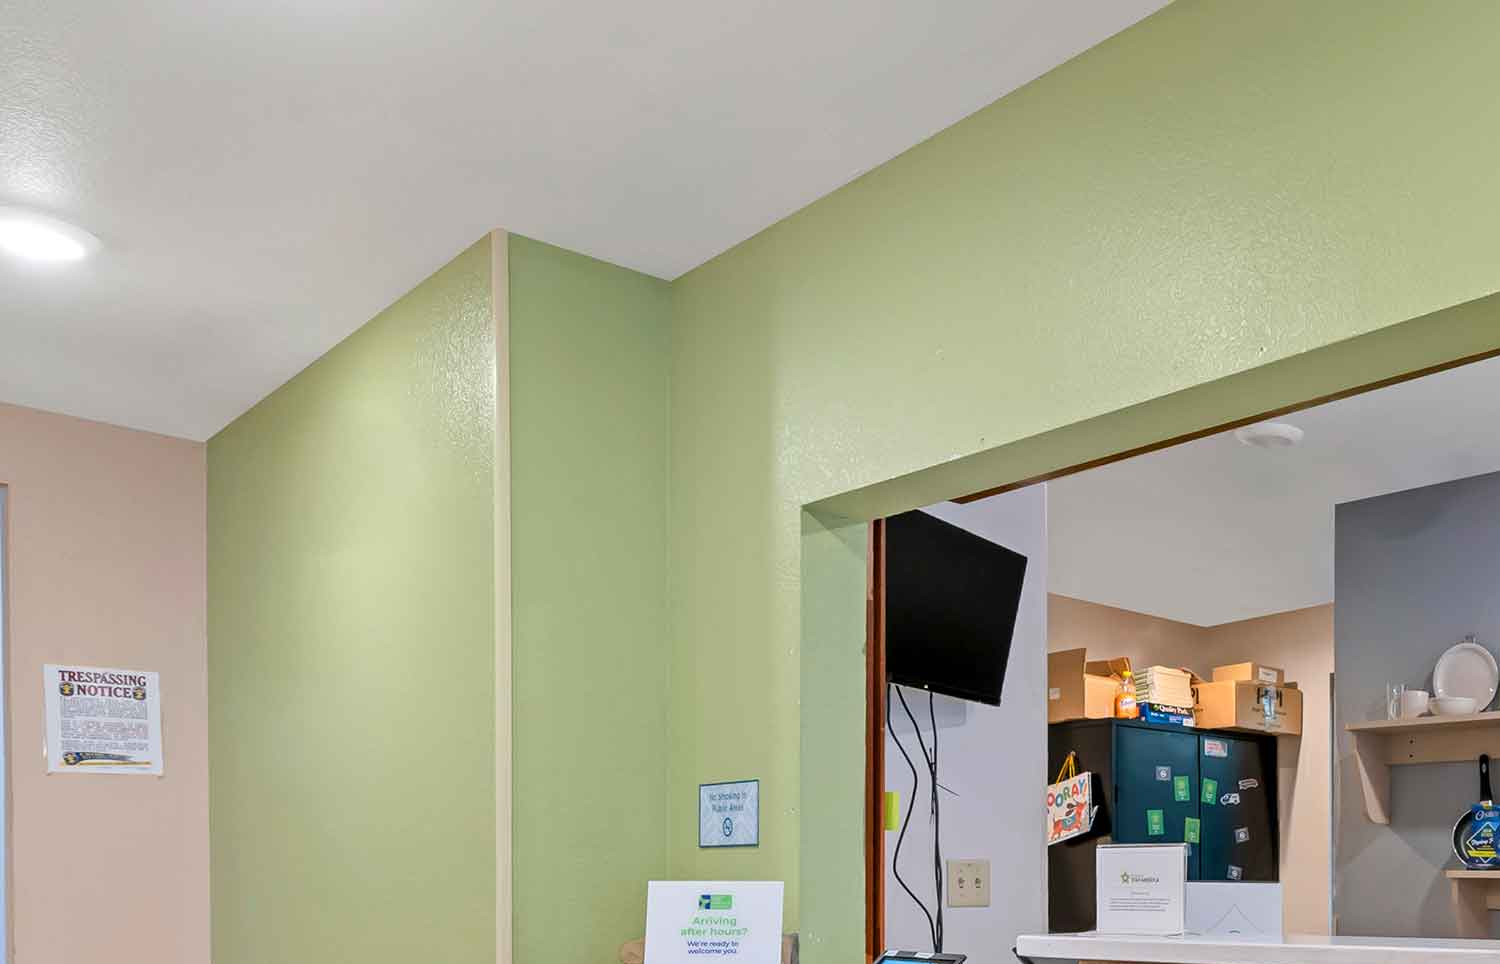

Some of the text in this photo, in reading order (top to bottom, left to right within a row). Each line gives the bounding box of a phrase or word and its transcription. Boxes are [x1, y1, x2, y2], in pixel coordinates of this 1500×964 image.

[58, 670, 147, 687] TRESPASSING
[77, 685, 132, 699] NOTICE
[1047, 778, 1088, 807] OORAY!
[692, 916, 737, 927] Arriving
[680, 927, 748, 937] after hours?
